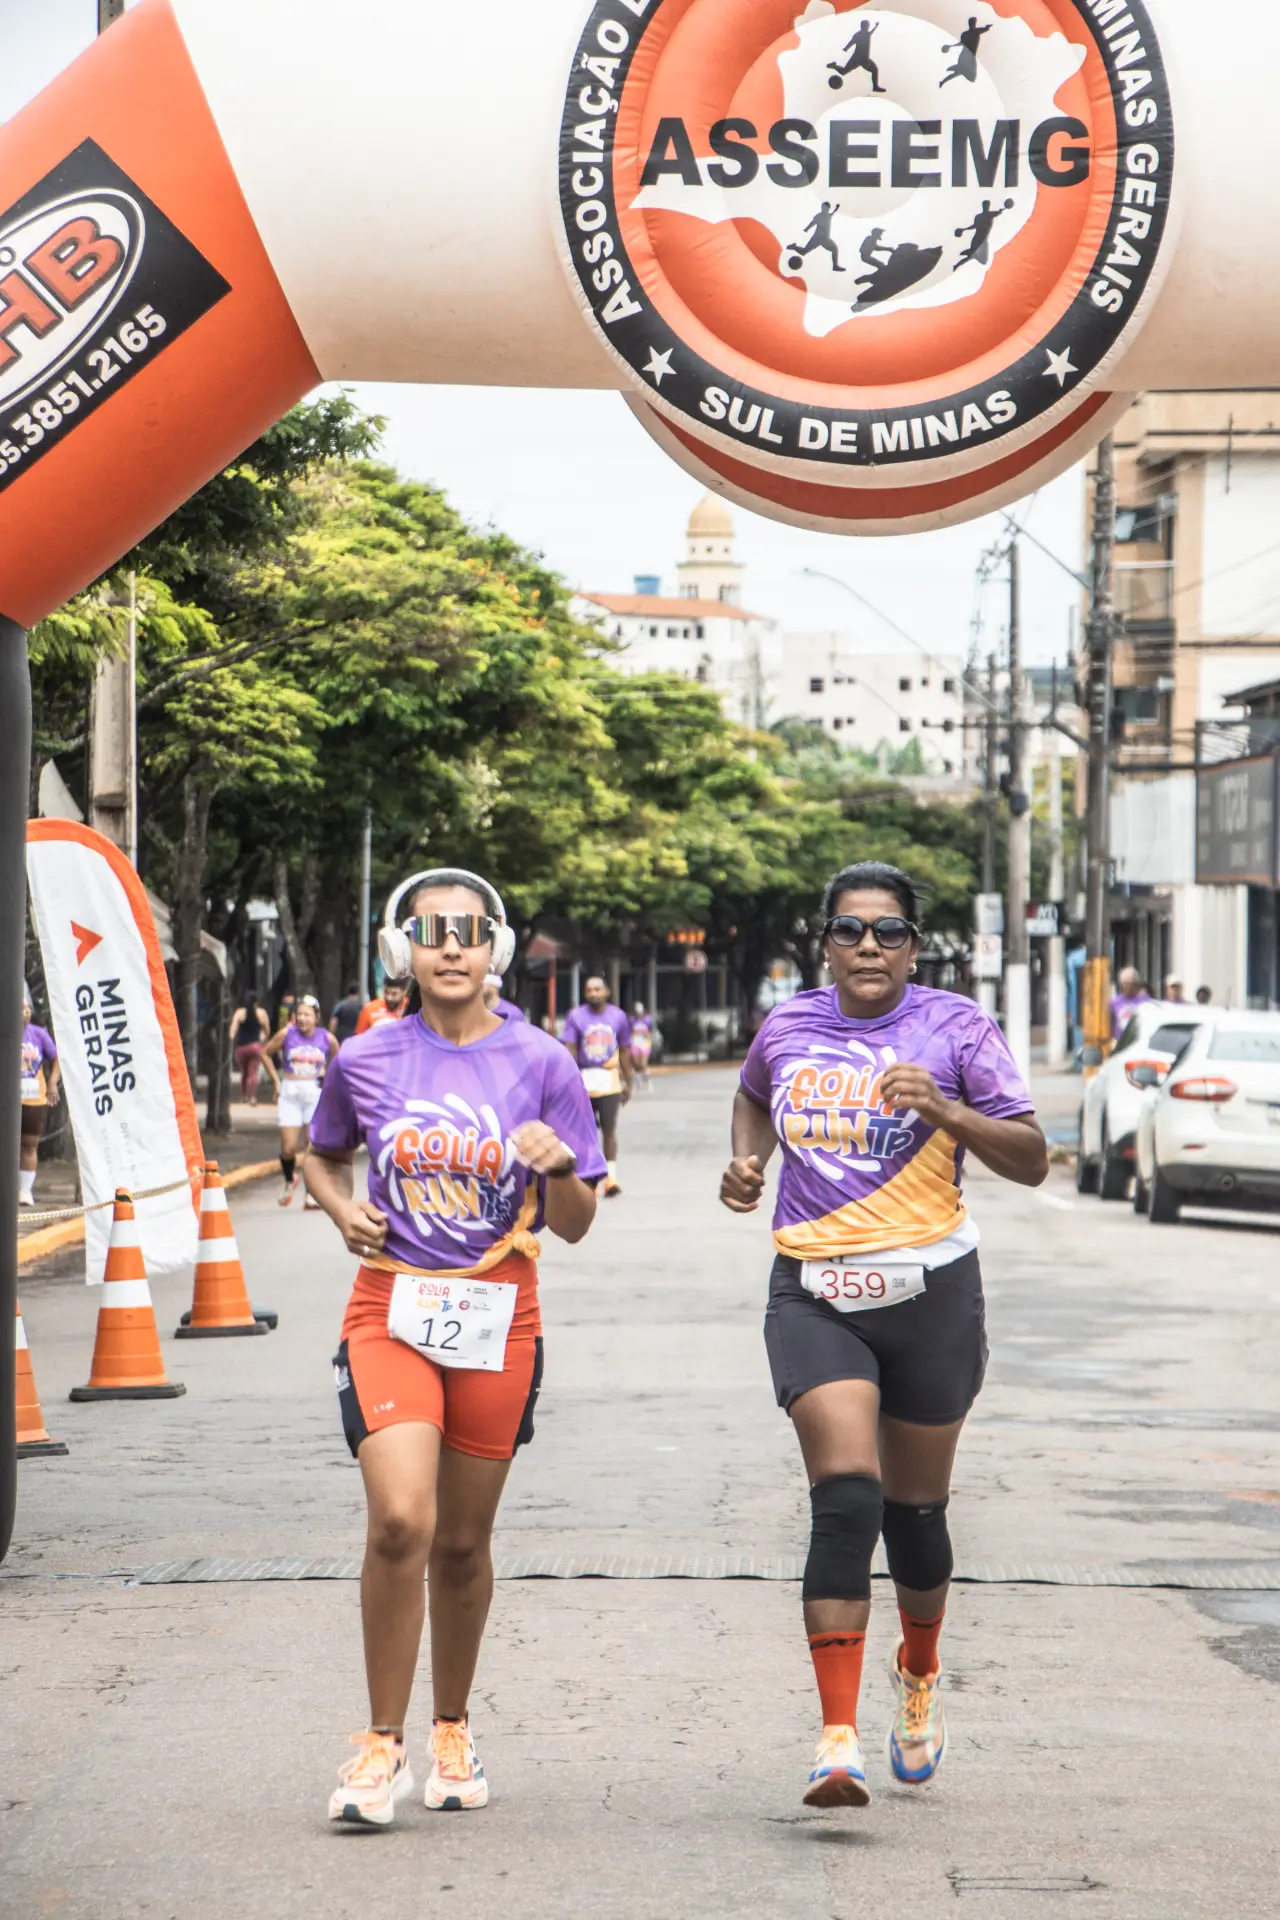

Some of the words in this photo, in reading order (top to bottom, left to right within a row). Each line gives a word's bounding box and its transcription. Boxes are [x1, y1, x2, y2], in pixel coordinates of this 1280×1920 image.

[571, 19, 643, 325] ASSOCIAÇÃO
[639, 116, 1090, 188] ASSEEMG
[1090, 143, 1160, 314] GERAIS
[699, 386, 784, 444] SUL
[799, 417, 858, 454] DE
[871, 390, 1017, 454] MINAS
[75, 983, 114, 1117] GERAIS
[97, 978, 136, 1094] MINAS
[819, 1269, 887, 1300] 359
[417, 1317, 462, 1351] 12
